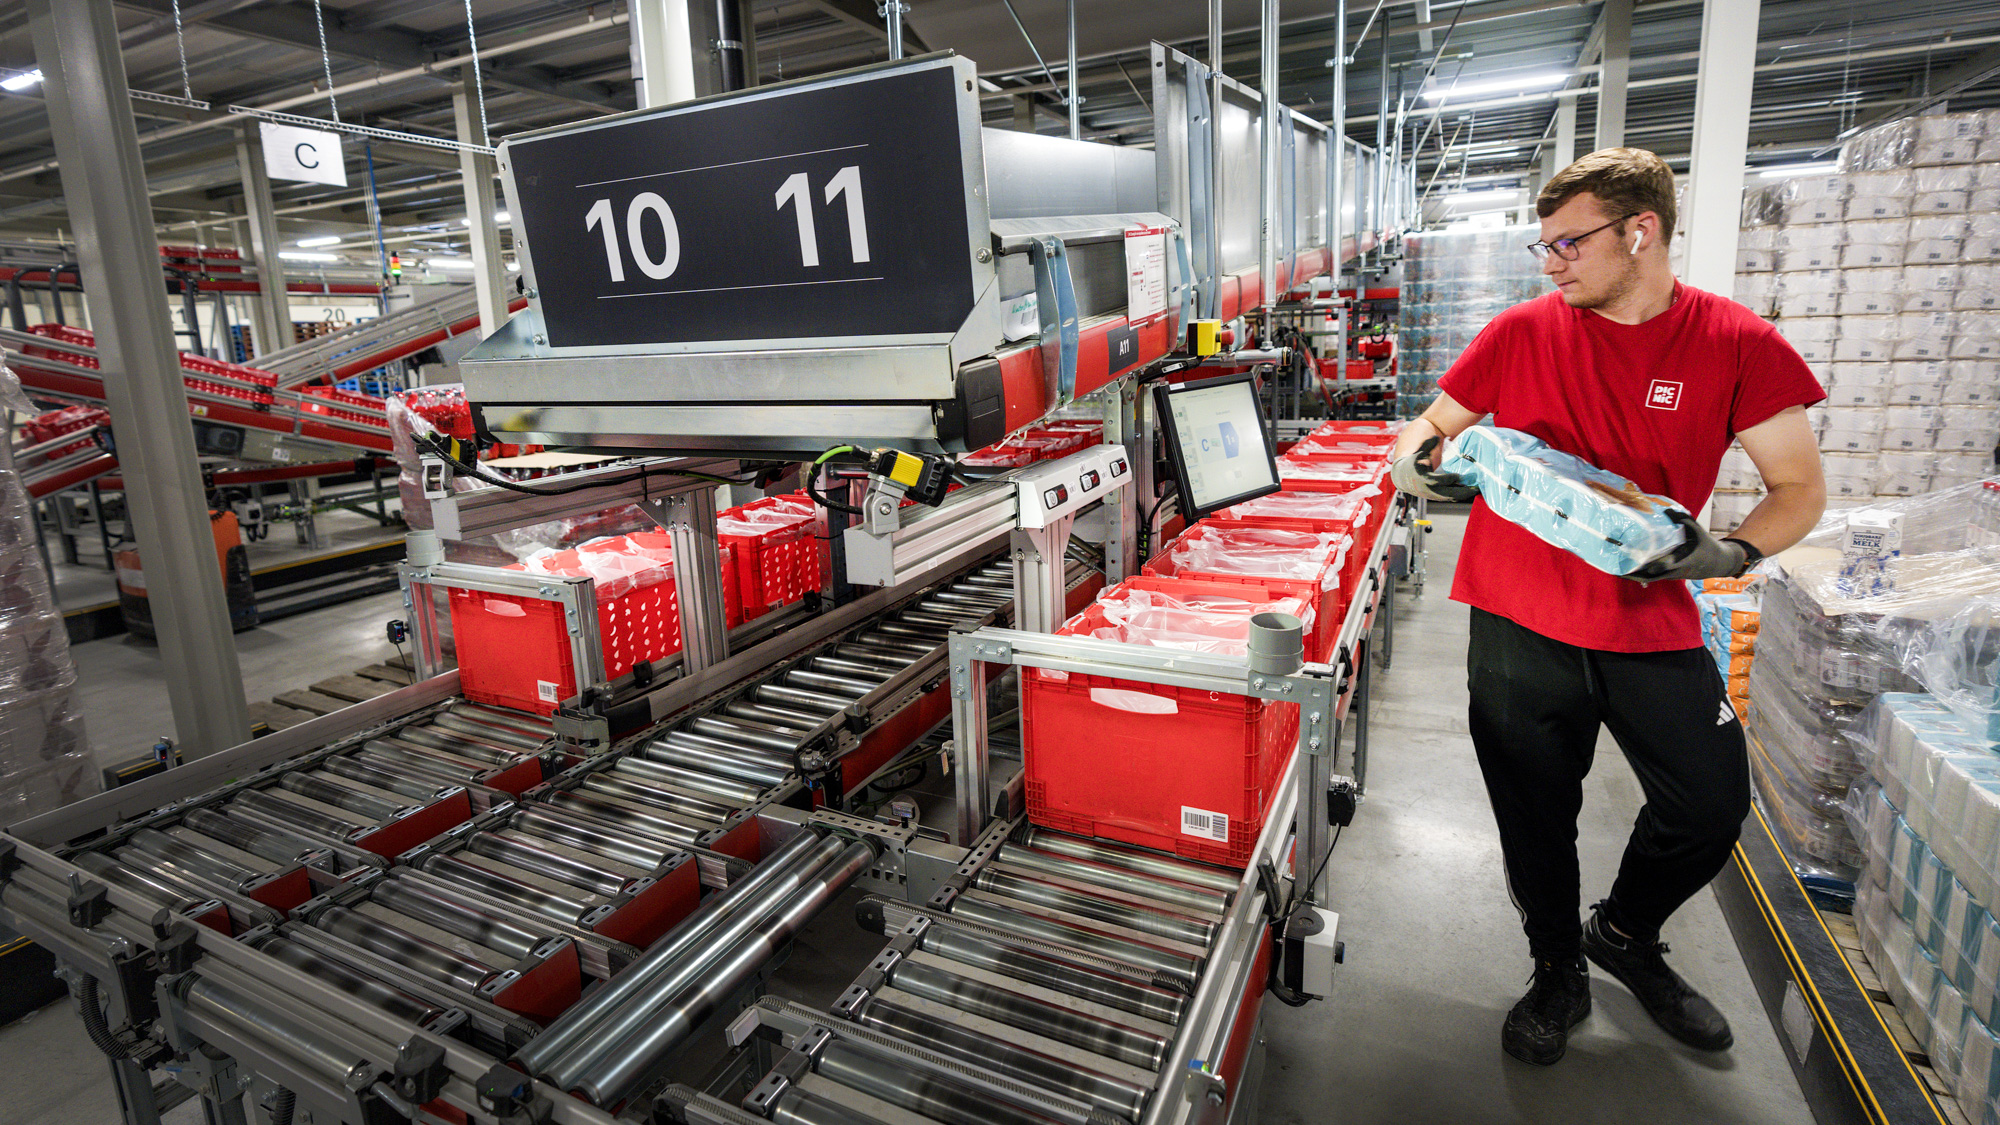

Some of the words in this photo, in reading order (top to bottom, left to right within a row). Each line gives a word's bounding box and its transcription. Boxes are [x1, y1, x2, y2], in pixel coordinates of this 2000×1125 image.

[295, 142, 319, 169] C
[585, 192, 680, 282] 10
[775, 165, 870, 267] 11
[323, 308, 345, 322] 20
[1119, 338, 1130, 356] A11
[1654, 385, 1676, 396] PIC
[1201, 438, 1209, 452] C
[1324, 521, 1330, 529] C
[1714, 581, 1733, 590] CAT
[1209, 690, 1219, 702] C
